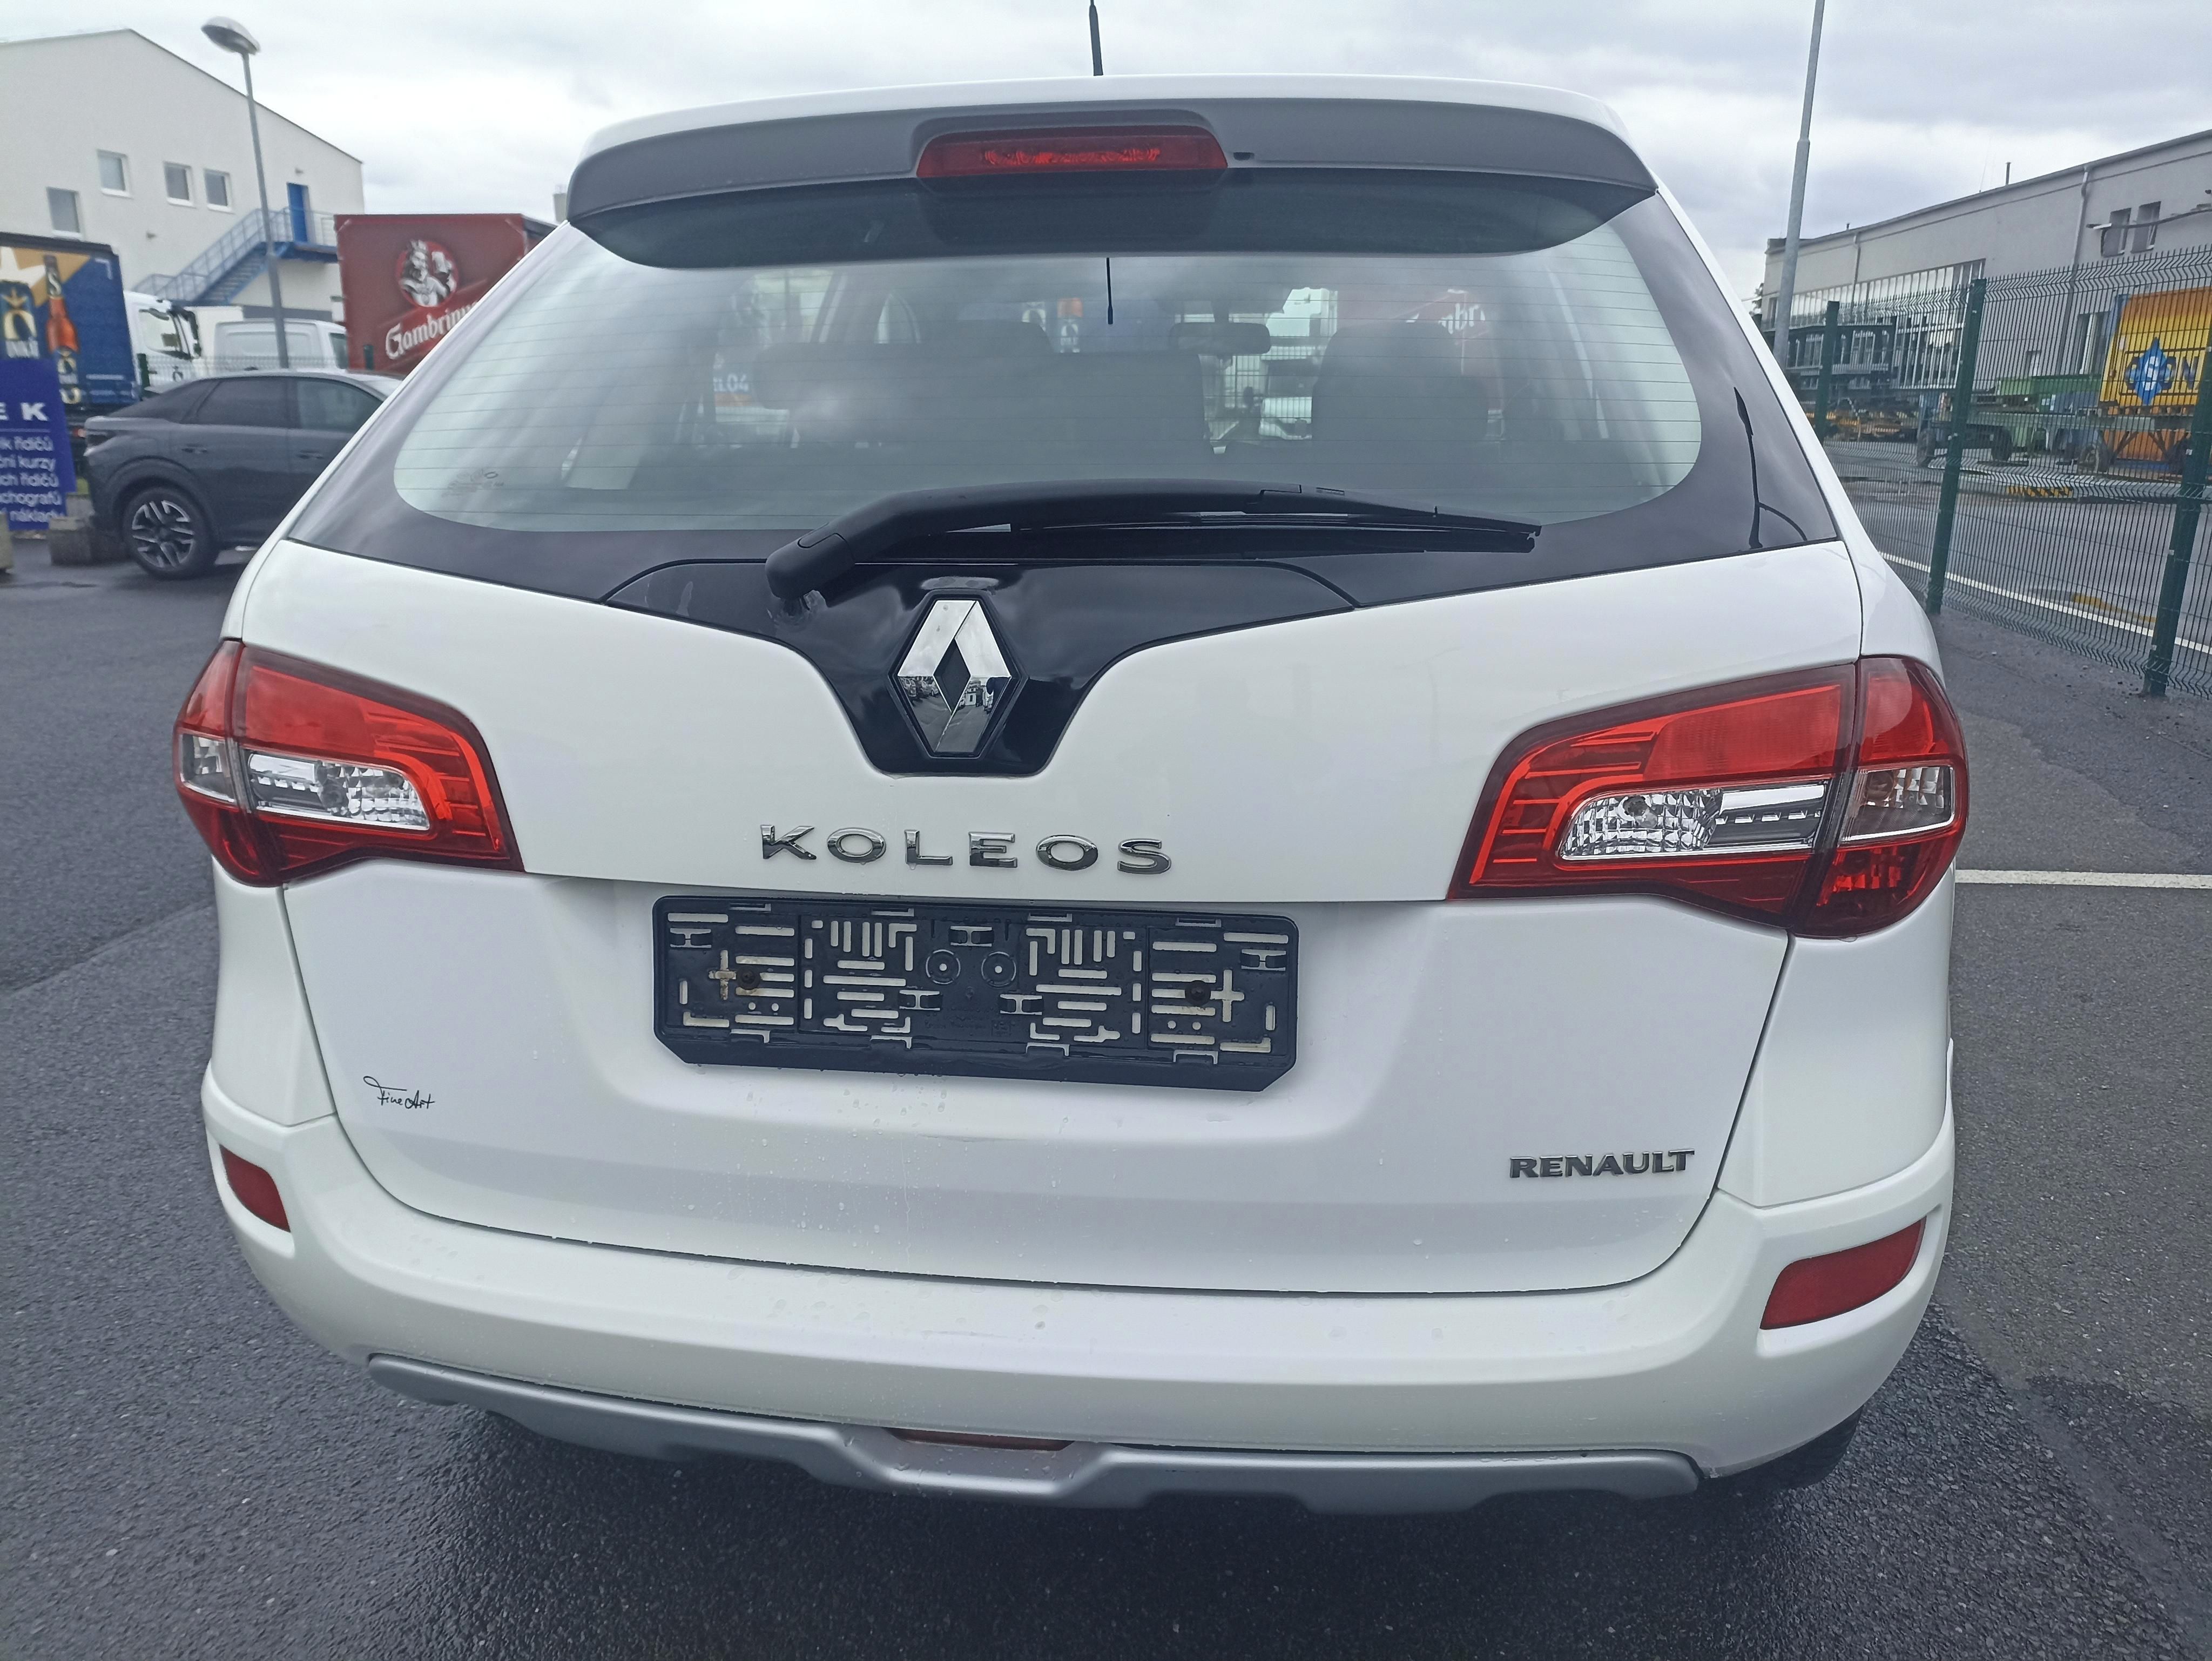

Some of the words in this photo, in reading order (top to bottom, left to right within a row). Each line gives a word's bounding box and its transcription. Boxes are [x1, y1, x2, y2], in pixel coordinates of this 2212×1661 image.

[385, 300, 478, 360] Gambrin
[18, 455, 56, 472] kurzy
[760, 824, 1172, 875] KOLEOS
[363, 1075, 407, 1106] Fine
[1509, 1149, 1695, 1178] RENAULT
